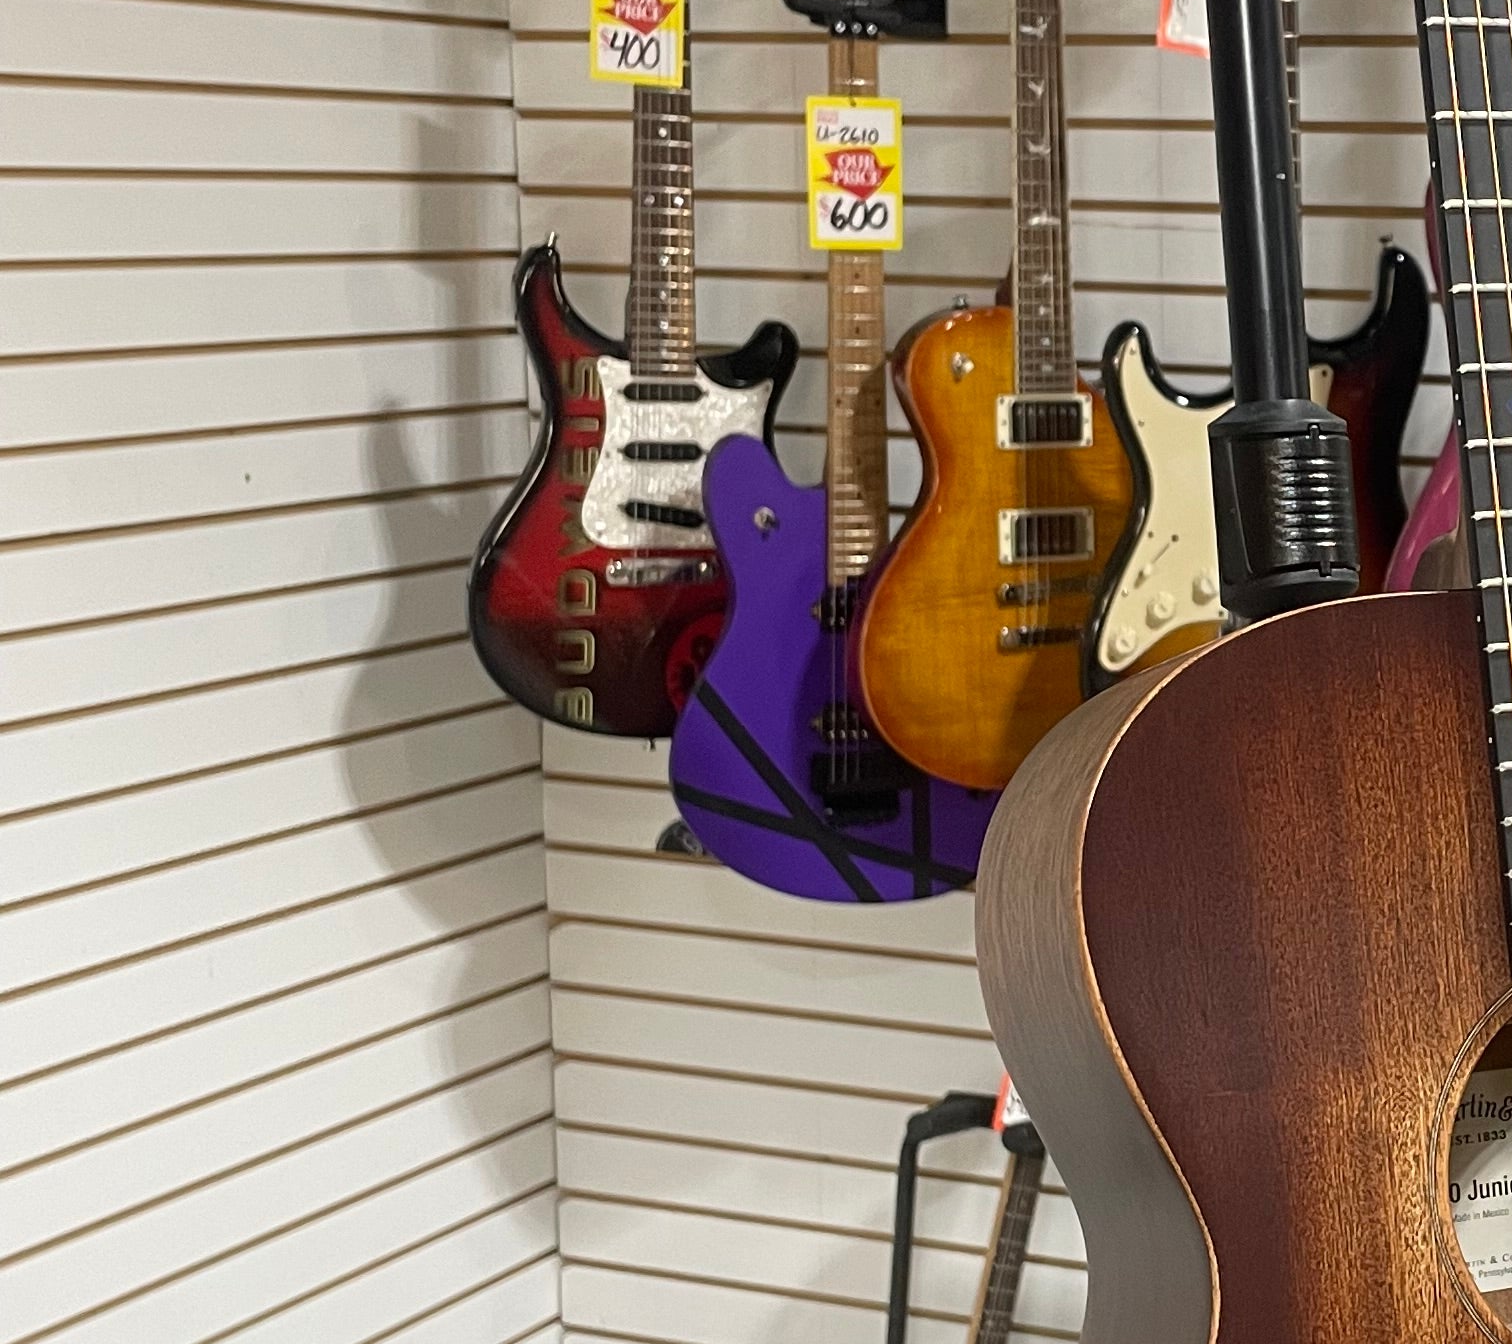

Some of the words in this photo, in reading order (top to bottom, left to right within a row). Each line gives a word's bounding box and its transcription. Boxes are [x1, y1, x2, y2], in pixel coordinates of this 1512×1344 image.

[837, 153, 876, 172] OUR
[1477, 1129, 1507, 1144] 1833
[1490, 1255, 1498, 1265] &
